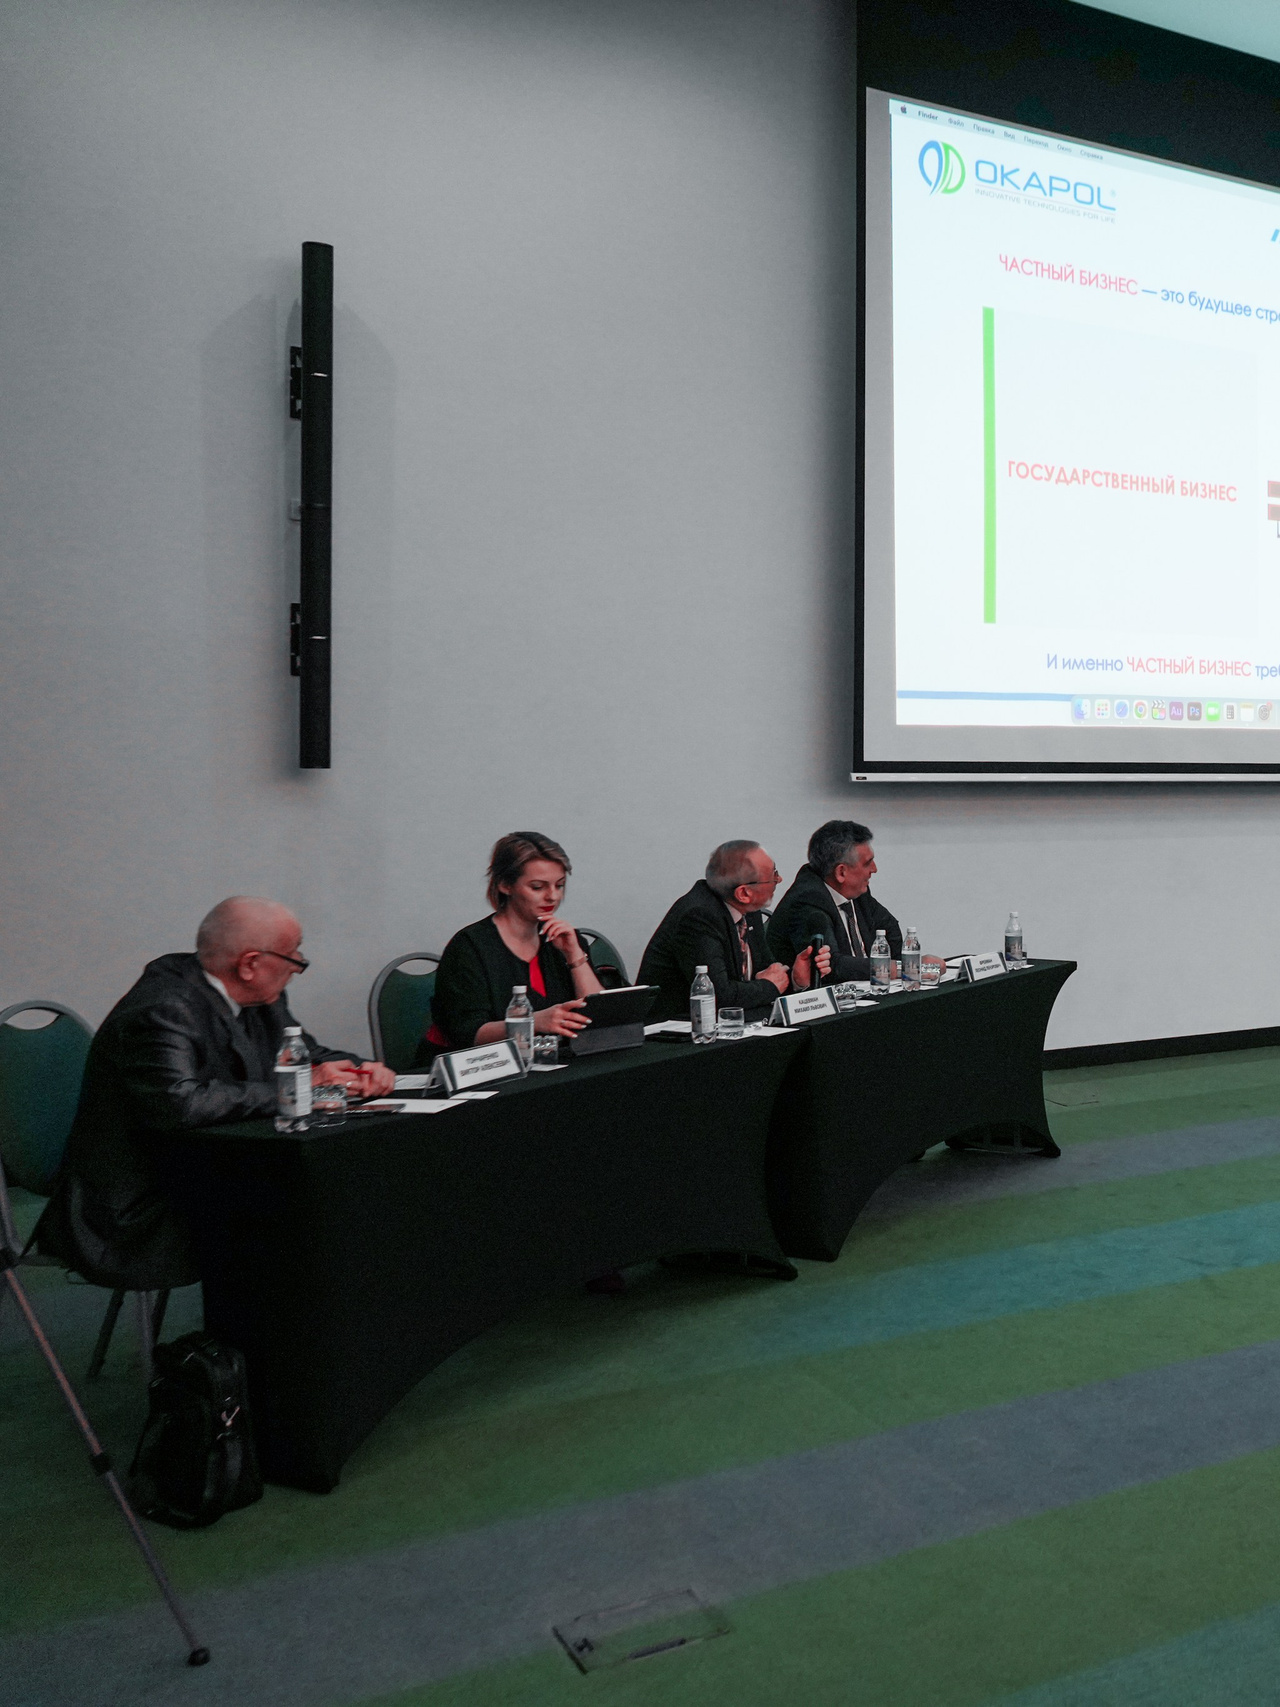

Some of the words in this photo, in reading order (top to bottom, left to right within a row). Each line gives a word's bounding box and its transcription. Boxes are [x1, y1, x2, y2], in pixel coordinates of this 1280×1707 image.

[917, 110, 939, 121] Finder
[973, 124, 996, 135] Правка
[1004, 130, 1016, 141] Вид
[1024, 135, 1050, 149] Переход
[1080, 149, 1104, 161] Справка
[975, 159, 1116, 211] OKAPOL
[975, 188, 1021, 204] INNOVATIVE
[1024, 199, 1081, 217] TECHNOLOGIES
[1083, 212, 1099, 221] FOR
[1101, 215, 1116, 225] LIFE
[999, 254, 1075, 283] ЧАСТНЫЙ
[1080, 270, 1138, 295] БИЗНЕС
[1161, 289, 1184, 304] это
[1188, 291, 1252, 317] будущее
[1008, 460, 1175, 495] ГОСУДАРСТВЕННЫЙ
[1180, 480, 1237, 502] БИЗНЕС
[1047, 653, 1058, 669] И
[1062, 658, 1124, 671] именно
[1127, 656, 1194, 675] ЧАСТНЫЙ
[1199, 659, 1252, 676] БИЗНЕС
[1171, 706, 1182, 715] Au
[1189, 706, 1200, 715] Ps
